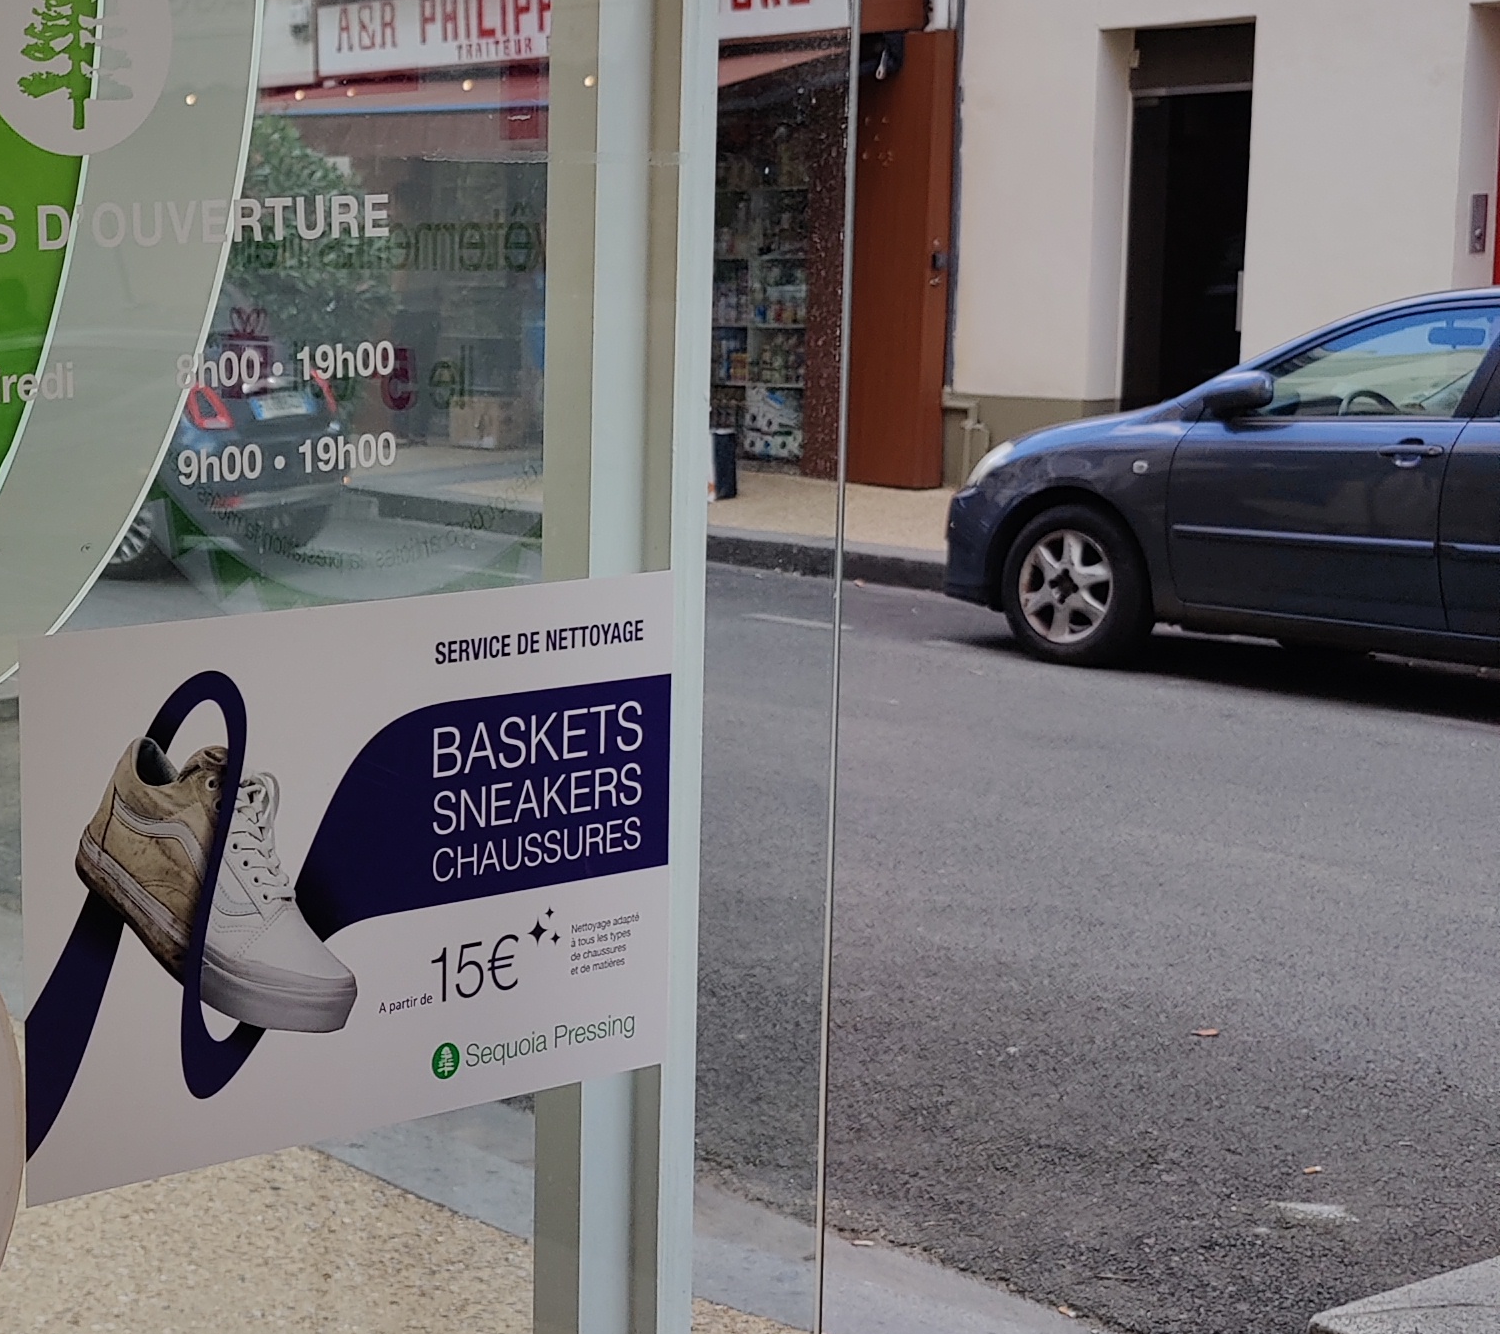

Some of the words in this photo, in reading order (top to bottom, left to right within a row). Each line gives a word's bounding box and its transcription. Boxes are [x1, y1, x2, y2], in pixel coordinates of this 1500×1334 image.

[336, 0, 398, 54] A&R
[456, 37, 533, 61] TRAITEUR
[36, 192, 390, 252] D'OUVERTURE
[176, 349, 261, 391] 8h00
[296, 340, 396, 381] 19h00
[177, 443, 263, 486] 9h00
[298, 431, 397, 474] 19h00
[434, 634, 511, 665] SERVICE
[517, 631, 540, 655] DE
[545, 619, 644, 652] NETTOYAGE
[433, 700, 644, 779] BASKETS
[432, 762, 643, 835] SNEAKERS
[431, 816, 642, 883] CHAUSSURES
[570, 921, 612, 934] Nettoyage
[612, 912, 640, 927] adapté
[570, 937, 576, 948] à
[578, 935, 595, 947] tous
[596, 933, 608, 943] les
[610, 929, 632, 942] types
[378, 1001, 387, 1014] A
[389, 995, 418, 1014] partir
[420, 992, 434, 1007] de
[430, 933, 520, 1003] 15€
[570, 951, 581, 962] de
[582, 943, 627, 960] chaussures
[570, 966, 579, 976] et
[580, 963, 591, 974] de
[592, 957, 626, 972] matières
[465, 1030, 548, 1068] Sequoia
[554, 1014, 637, 1049] Pressing
